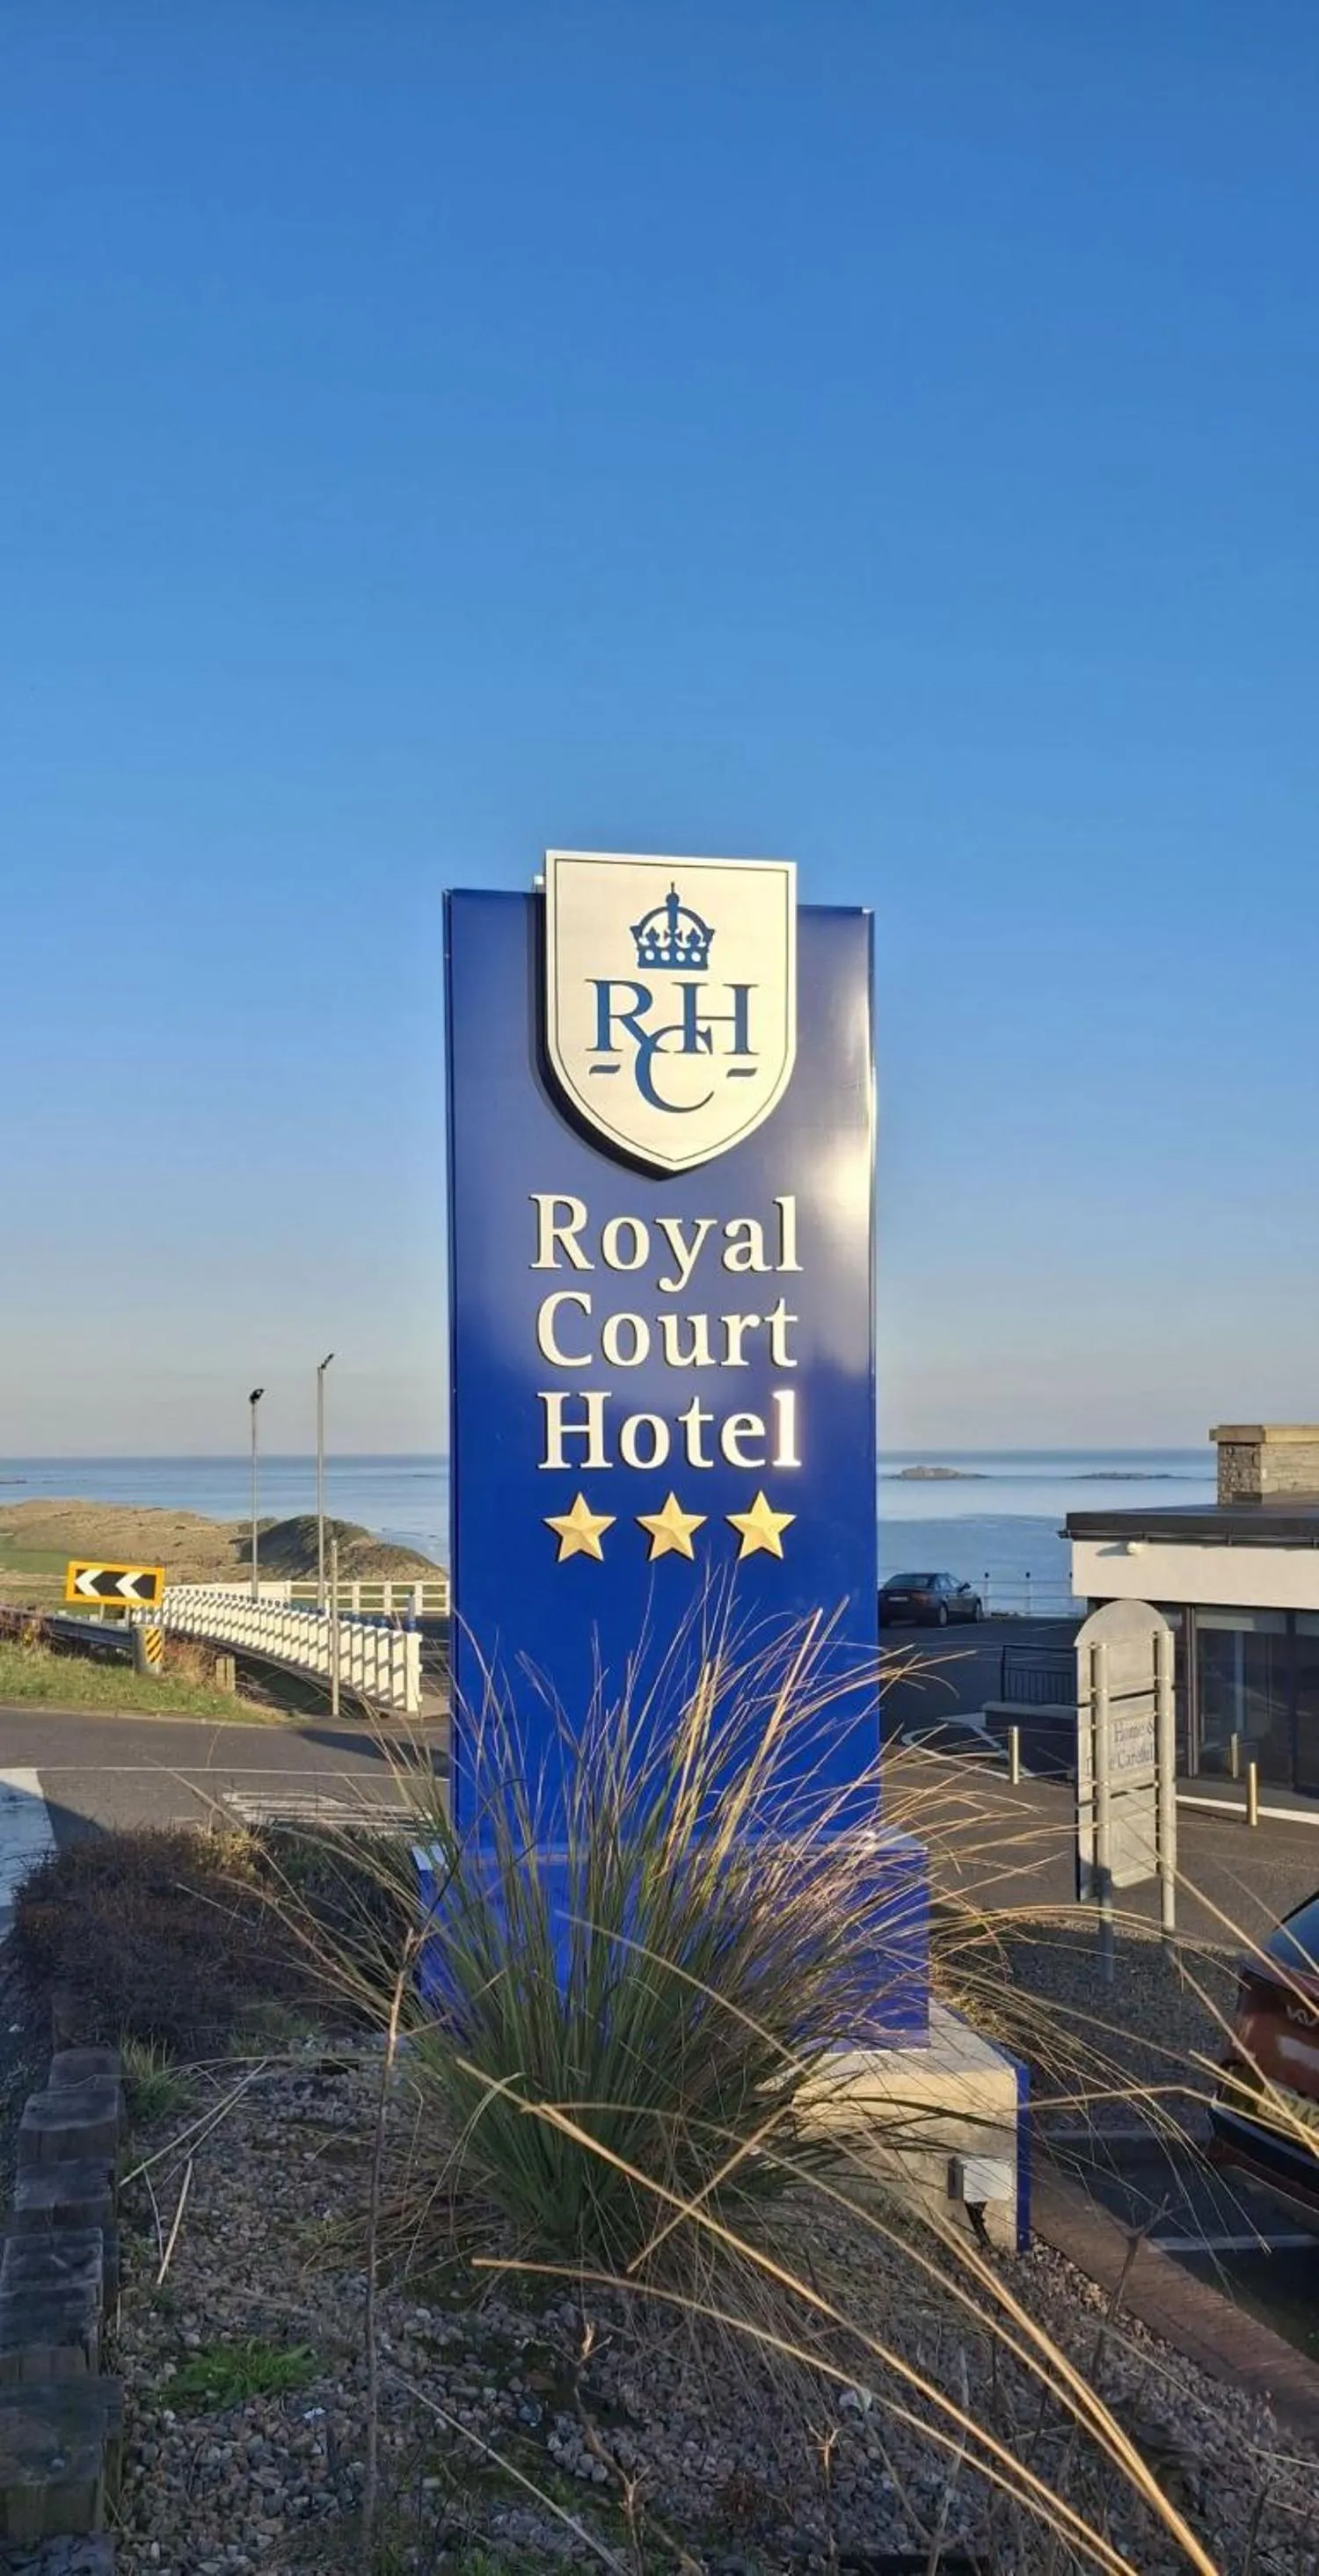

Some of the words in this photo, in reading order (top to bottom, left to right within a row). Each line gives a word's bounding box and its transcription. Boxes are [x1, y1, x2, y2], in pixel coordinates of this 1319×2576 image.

[529, 1194, 804, 1293] Royal
[536, 1291, 798, 1368] Court
[536, 1389, 802, 1470] Hotel
[1117, 1741, 1155, 1770] Careful
